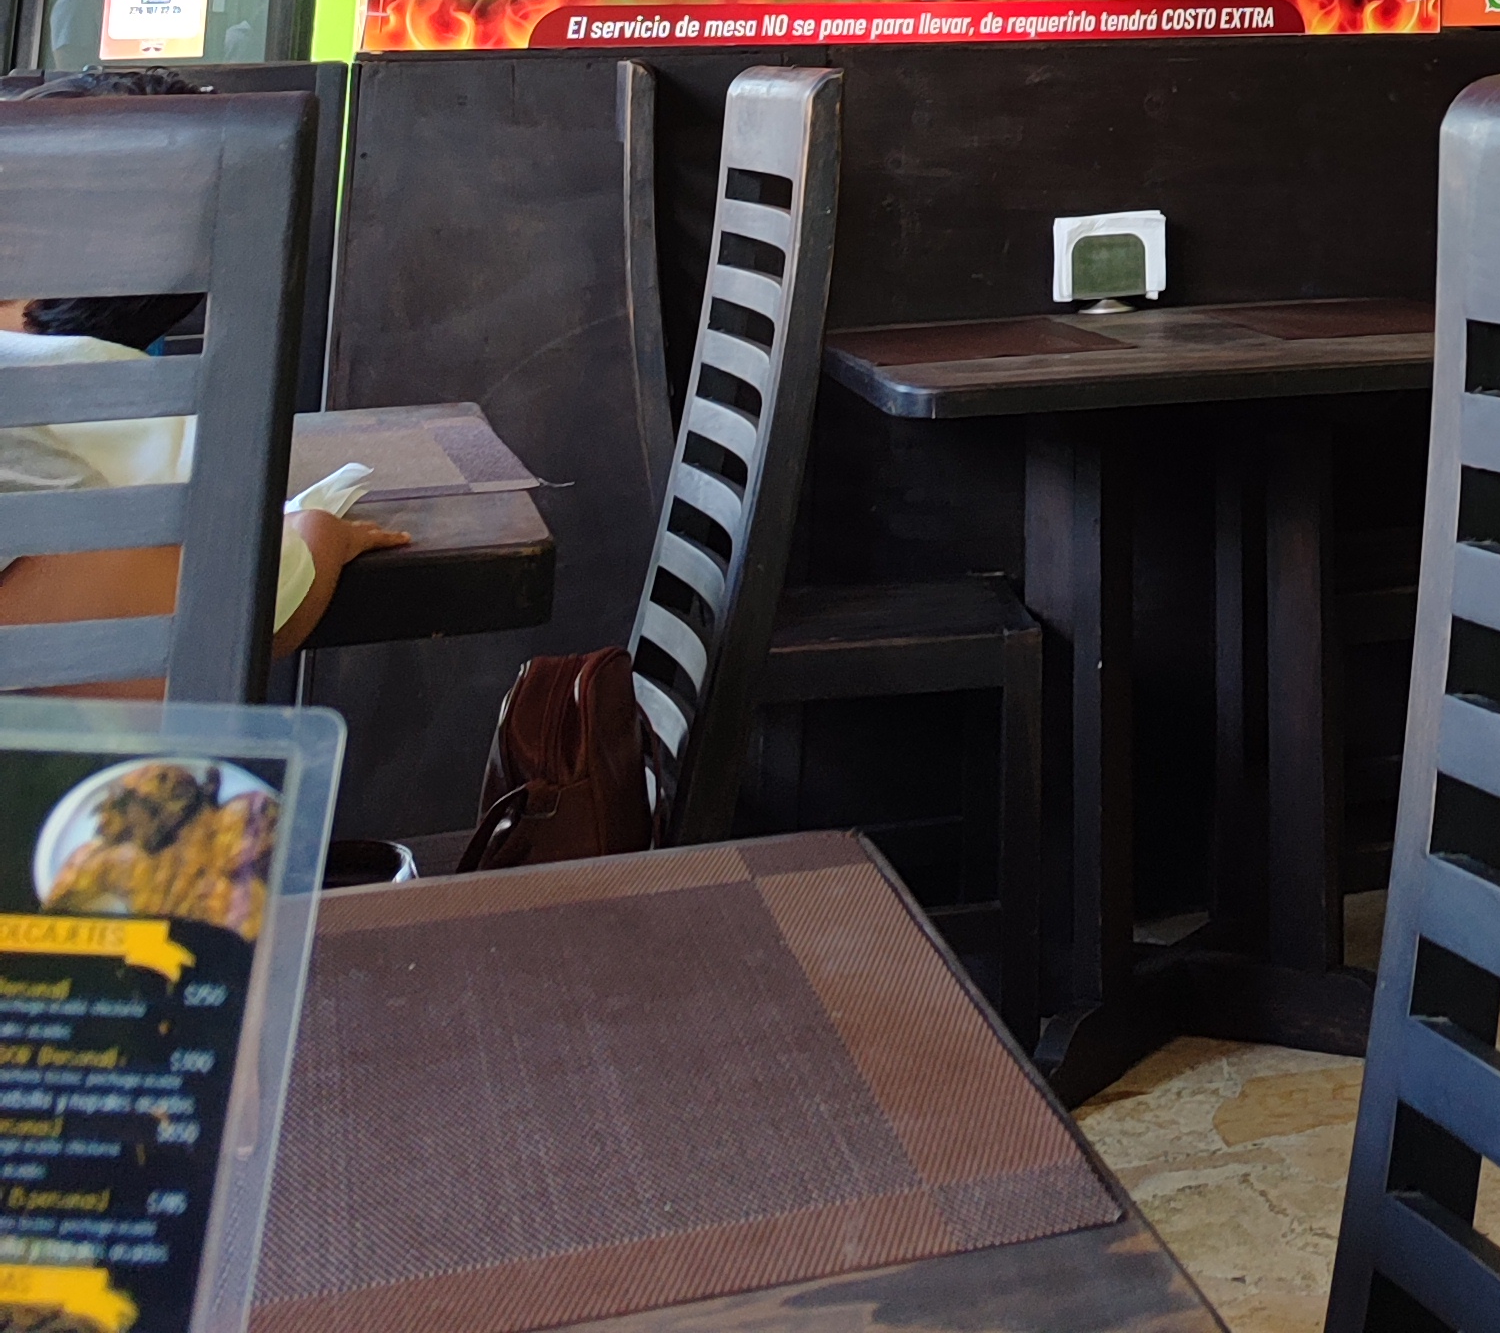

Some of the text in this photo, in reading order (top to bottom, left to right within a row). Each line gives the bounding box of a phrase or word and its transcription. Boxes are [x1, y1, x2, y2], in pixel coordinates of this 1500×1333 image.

[567, 7, 1275, 42] El servicio de mesa NO se pone para llevar, de requerirlo tendrá COSTO EXTRA
